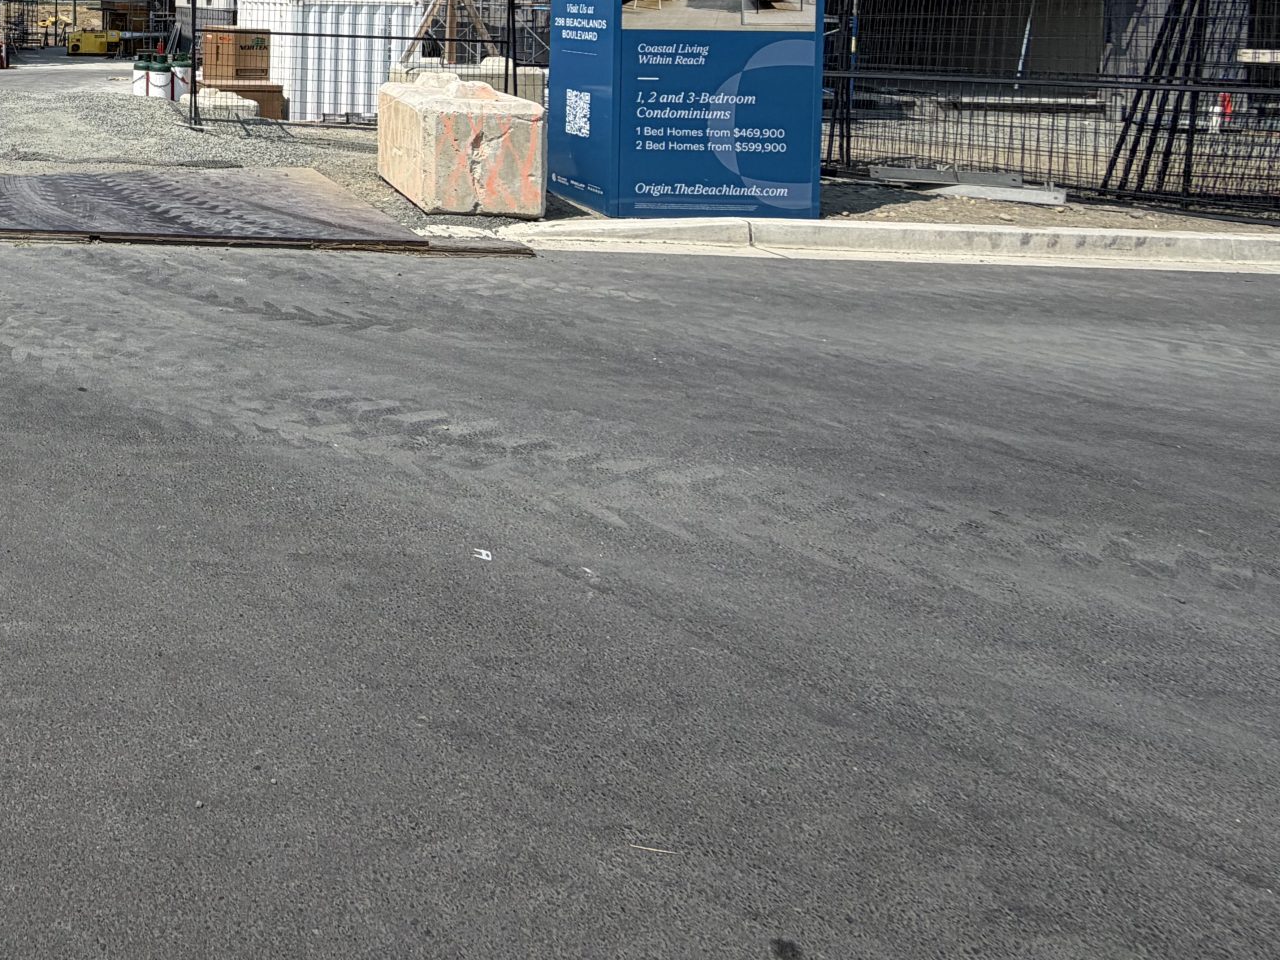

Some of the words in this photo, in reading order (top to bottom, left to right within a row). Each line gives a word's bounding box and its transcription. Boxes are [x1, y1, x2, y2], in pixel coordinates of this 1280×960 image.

[566, 3, 579, 14] Visit
[579, 3, 587, 14] Us
[587, 5, 595, 14] at
[565, 17, 607, 29] BEACHLANDS
[561, 29, 598, 41] BOULEVARD
[637, 43, 676, 53] Coastal
[678, 44, 709, 56] Living
[638, 54, 672, 65] Within
[674, 55, 706, 65] Reach
[636, 91, 645, 104] 1,
[647, 91, 657, 103] 2
[659, 92, 684, 104] and
[686, 92, 756, 105] 3-Bedroom
[636, 106, 732, 120] Condominiums
[635, 126, 642, 136] 1
[643, 126, 664, 137] Bed
[667, 127, 703, 137] Homes
[706, 127, 731, 138] from
[733, 127, 786, 139] $469,900
[635, 140, 643, 150] 2
[645, 141, 666, 151] Bed
[668, 141, 705, 151] Homes
[707, 141, 732, 152] from
[734, 141, 787, 153] $599,900
[634, 182, 789, 197] Origin.TheBeachlands.com
